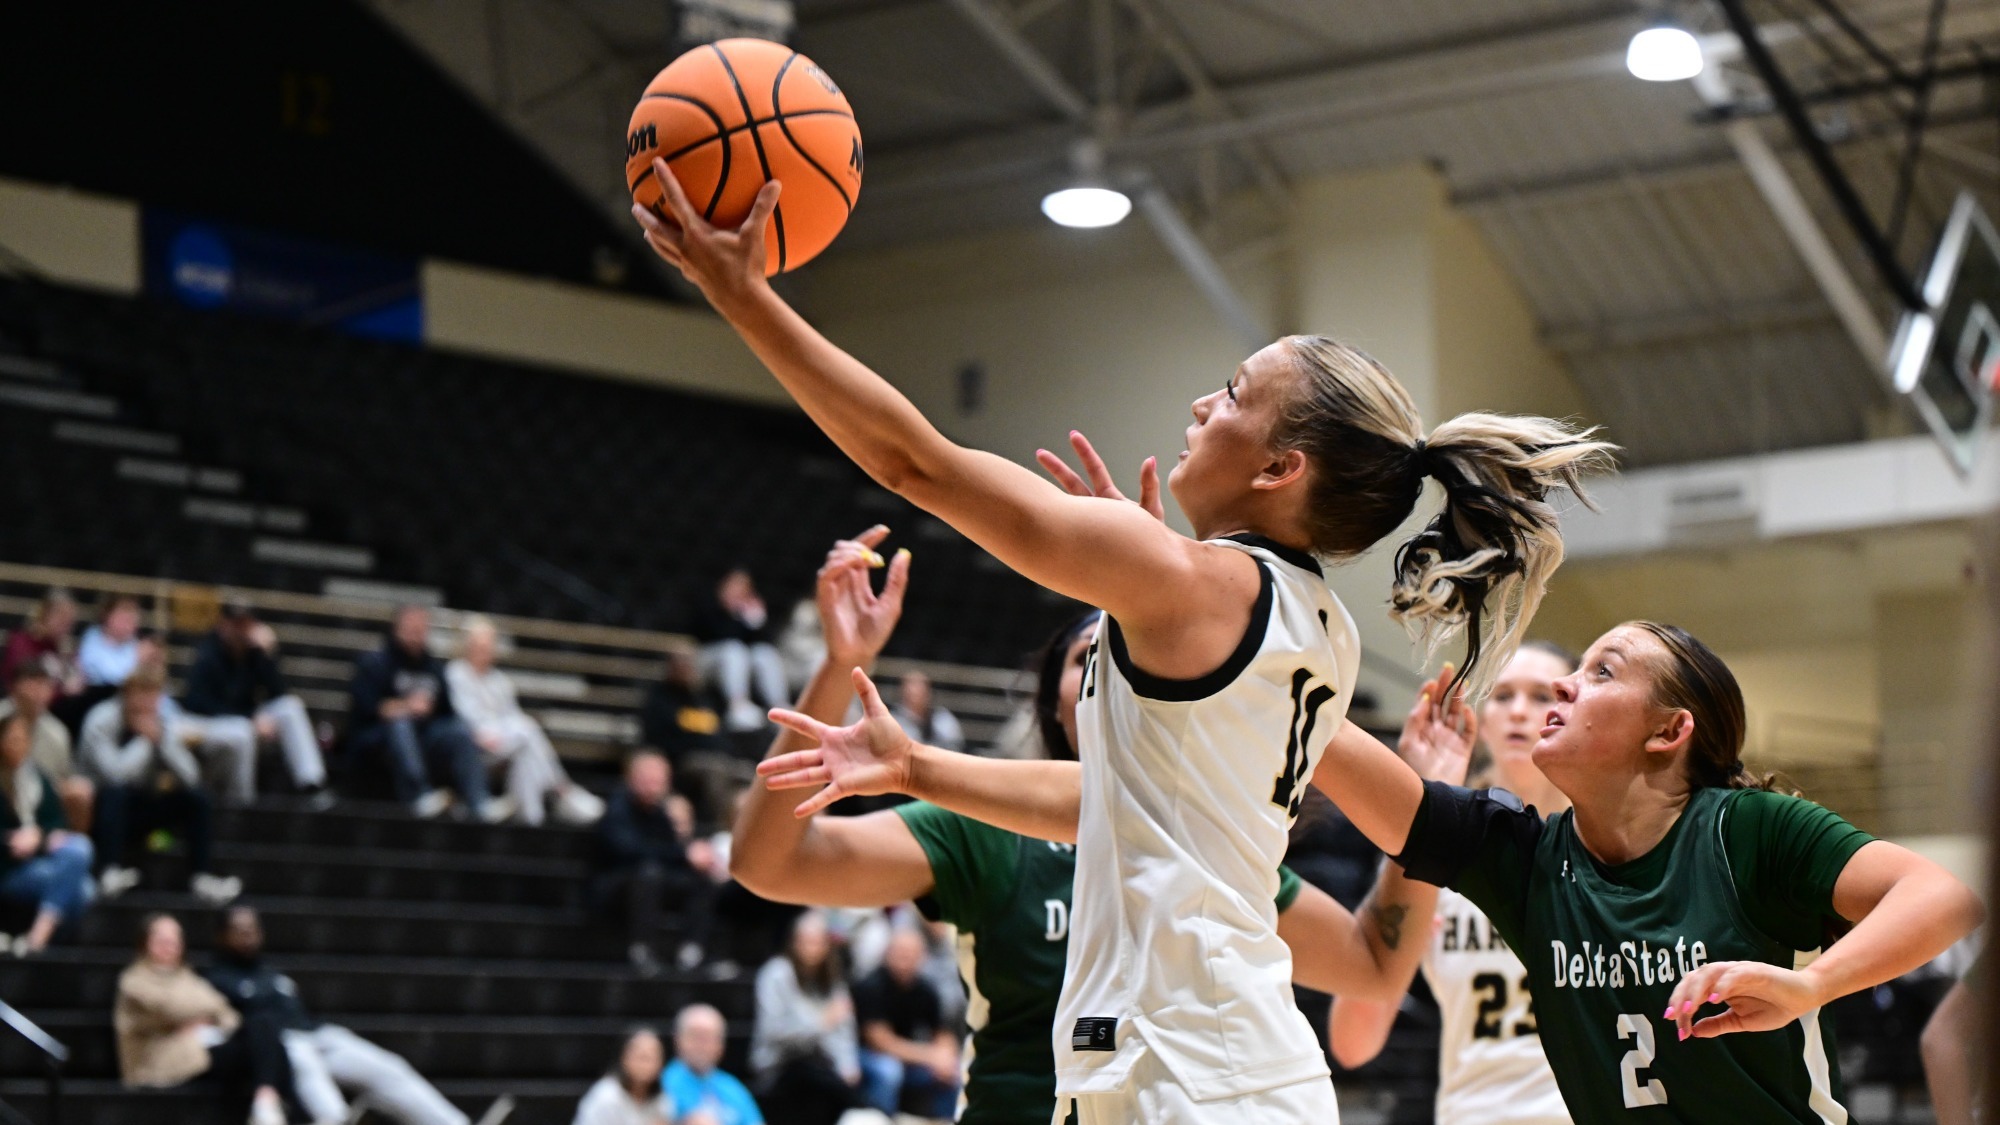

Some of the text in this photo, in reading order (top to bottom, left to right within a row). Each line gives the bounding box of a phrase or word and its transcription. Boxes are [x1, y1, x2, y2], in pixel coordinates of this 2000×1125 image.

[1551, 935, 1708, 989] Delta State
[1098, 1027, 1107, 1040] S
[1616, 1013, 1668, 1109] 2
